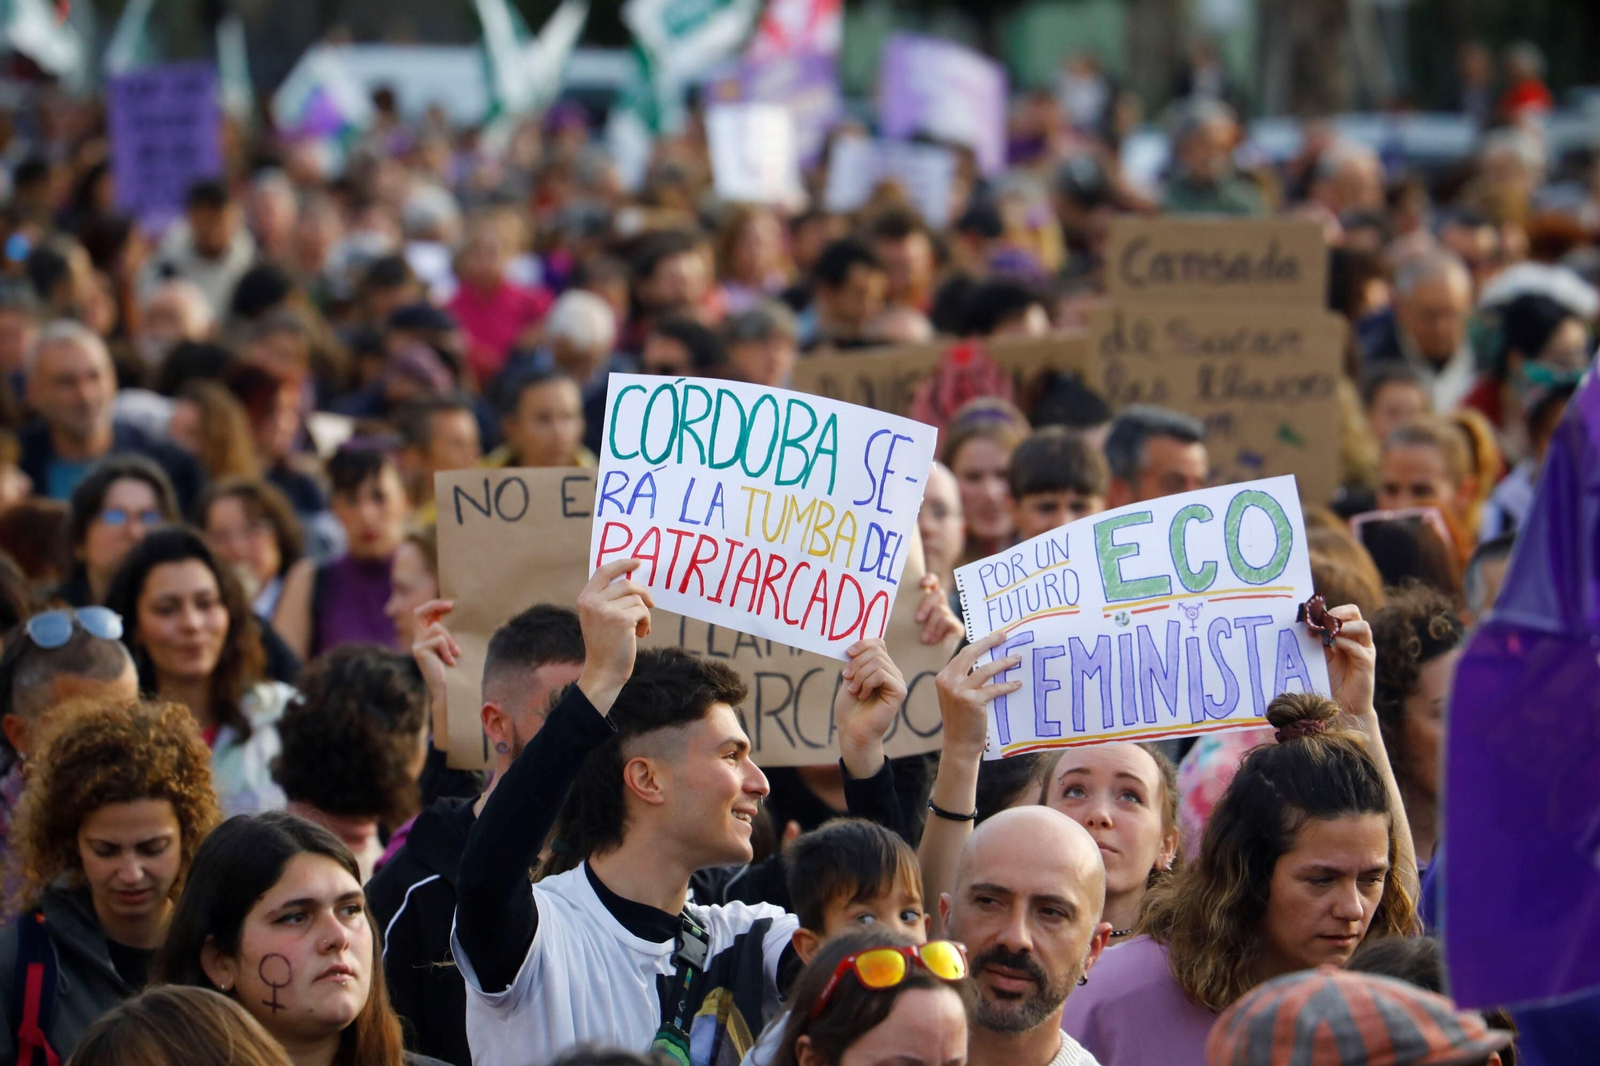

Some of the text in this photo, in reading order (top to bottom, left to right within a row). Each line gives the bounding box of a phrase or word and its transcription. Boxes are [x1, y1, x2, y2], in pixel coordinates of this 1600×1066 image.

[453, 476, 530, 526] NO
[609, 378, 838, 496] CÓRDOBA
[853, 429, 918, 514] SE-
[596, 521, 890, 641] PATRIARCADO
[597, 465, 904, 586] RÁ LA TUMBA DEL
[979, 532, 1070, 598] POR UN
[1093, 489, 1293, 603] ECO
[986, 568, 1080, 632] FUTURO
